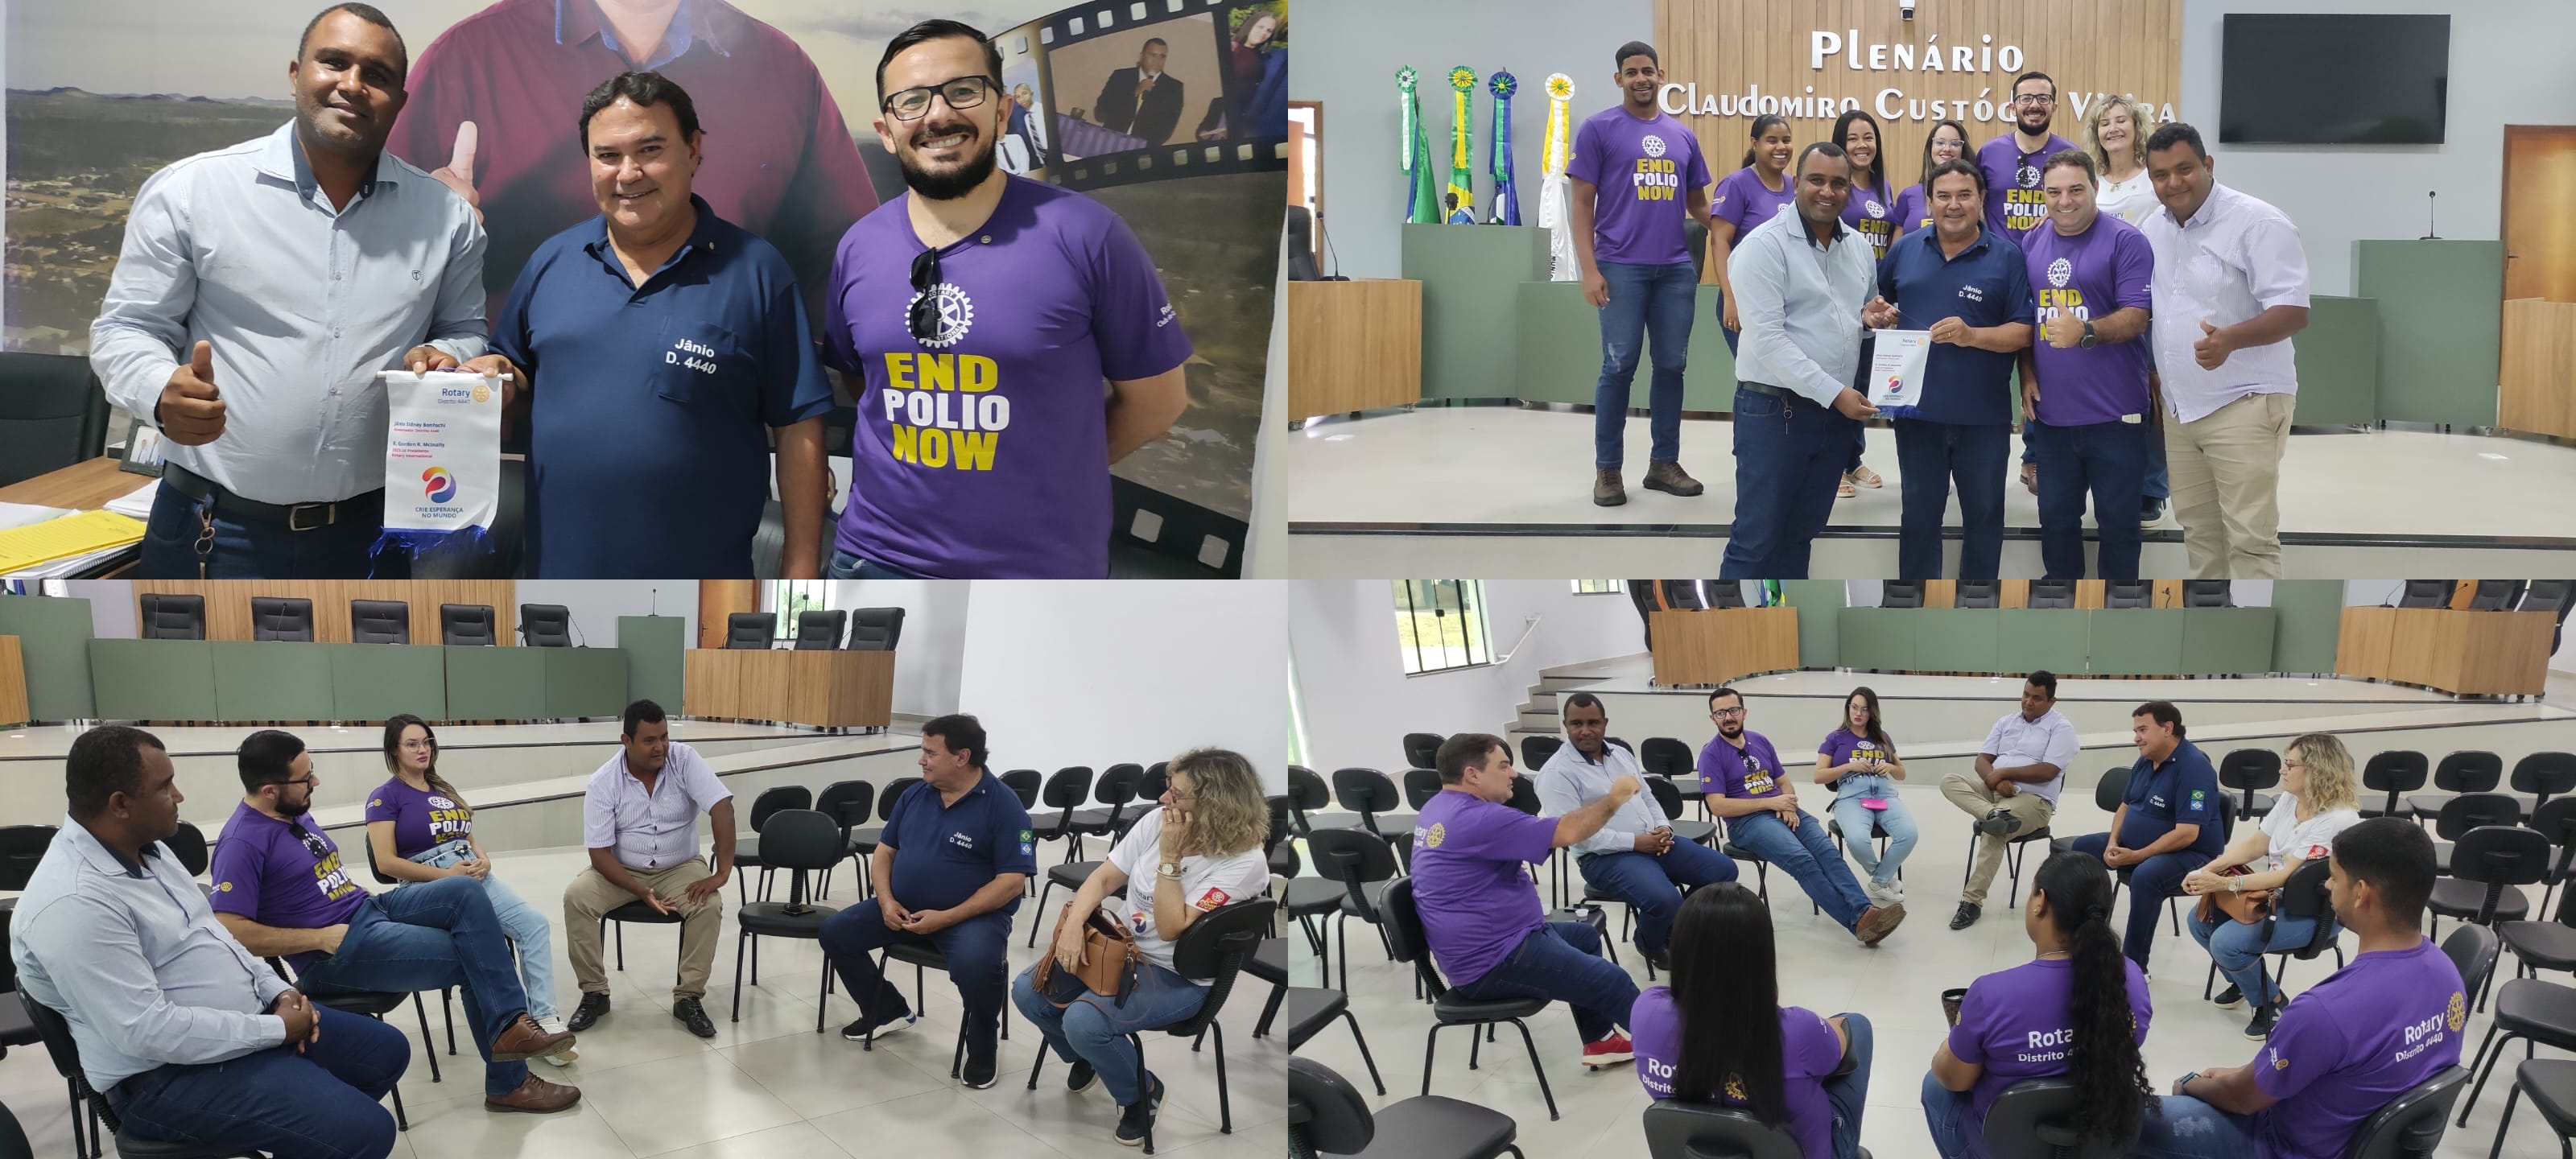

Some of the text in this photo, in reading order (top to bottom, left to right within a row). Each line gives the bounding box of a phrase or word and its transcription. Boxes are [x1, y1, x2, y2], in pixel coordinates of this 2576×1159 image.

[1875, 88, 2017, 122] Custód
[1637, 159, 1675, 173] END
[1633, 173, 1678, 187] POLIO
[1637, 186, 1675, 201] NOW
[2007, 188, 2046, 204] END
[2004, 202, 2047, 217] POLIO
[1860, 218, 1890, 233] END
[1963, 284, 1982, 295] Jânio
[1967, 293, 1983, 302] 4440
[2039, 289, 2083, 307] END
[2037, 306, 2089, 323] POO
[675, 338, 715, 358] Jânio
[665, 351, 716, 374] D. 4440
[884, 353, 998, 392] END
[442, 388, 470, 398] Rotary
[882, 388, 1010, 431] POLIO
[892, 423, 999, 471] NOW
[1852, 749, 1885, 759] END
[429, 808, 469, 821] END
[429, 820, 472, 835] POLIO
[954, 831, 972, 842] Jânio
[956, 839, 972, 849] 4440
[316, 865, 349, 895] POLI
[2405, 1013, 2444, 1045] Rotary
[2028, 1028, 2074, 1049] Rota
[2396, 1032, 2443, 1062] Distrito 4440
[2018, 1052, 2064, 1062] Distrito
